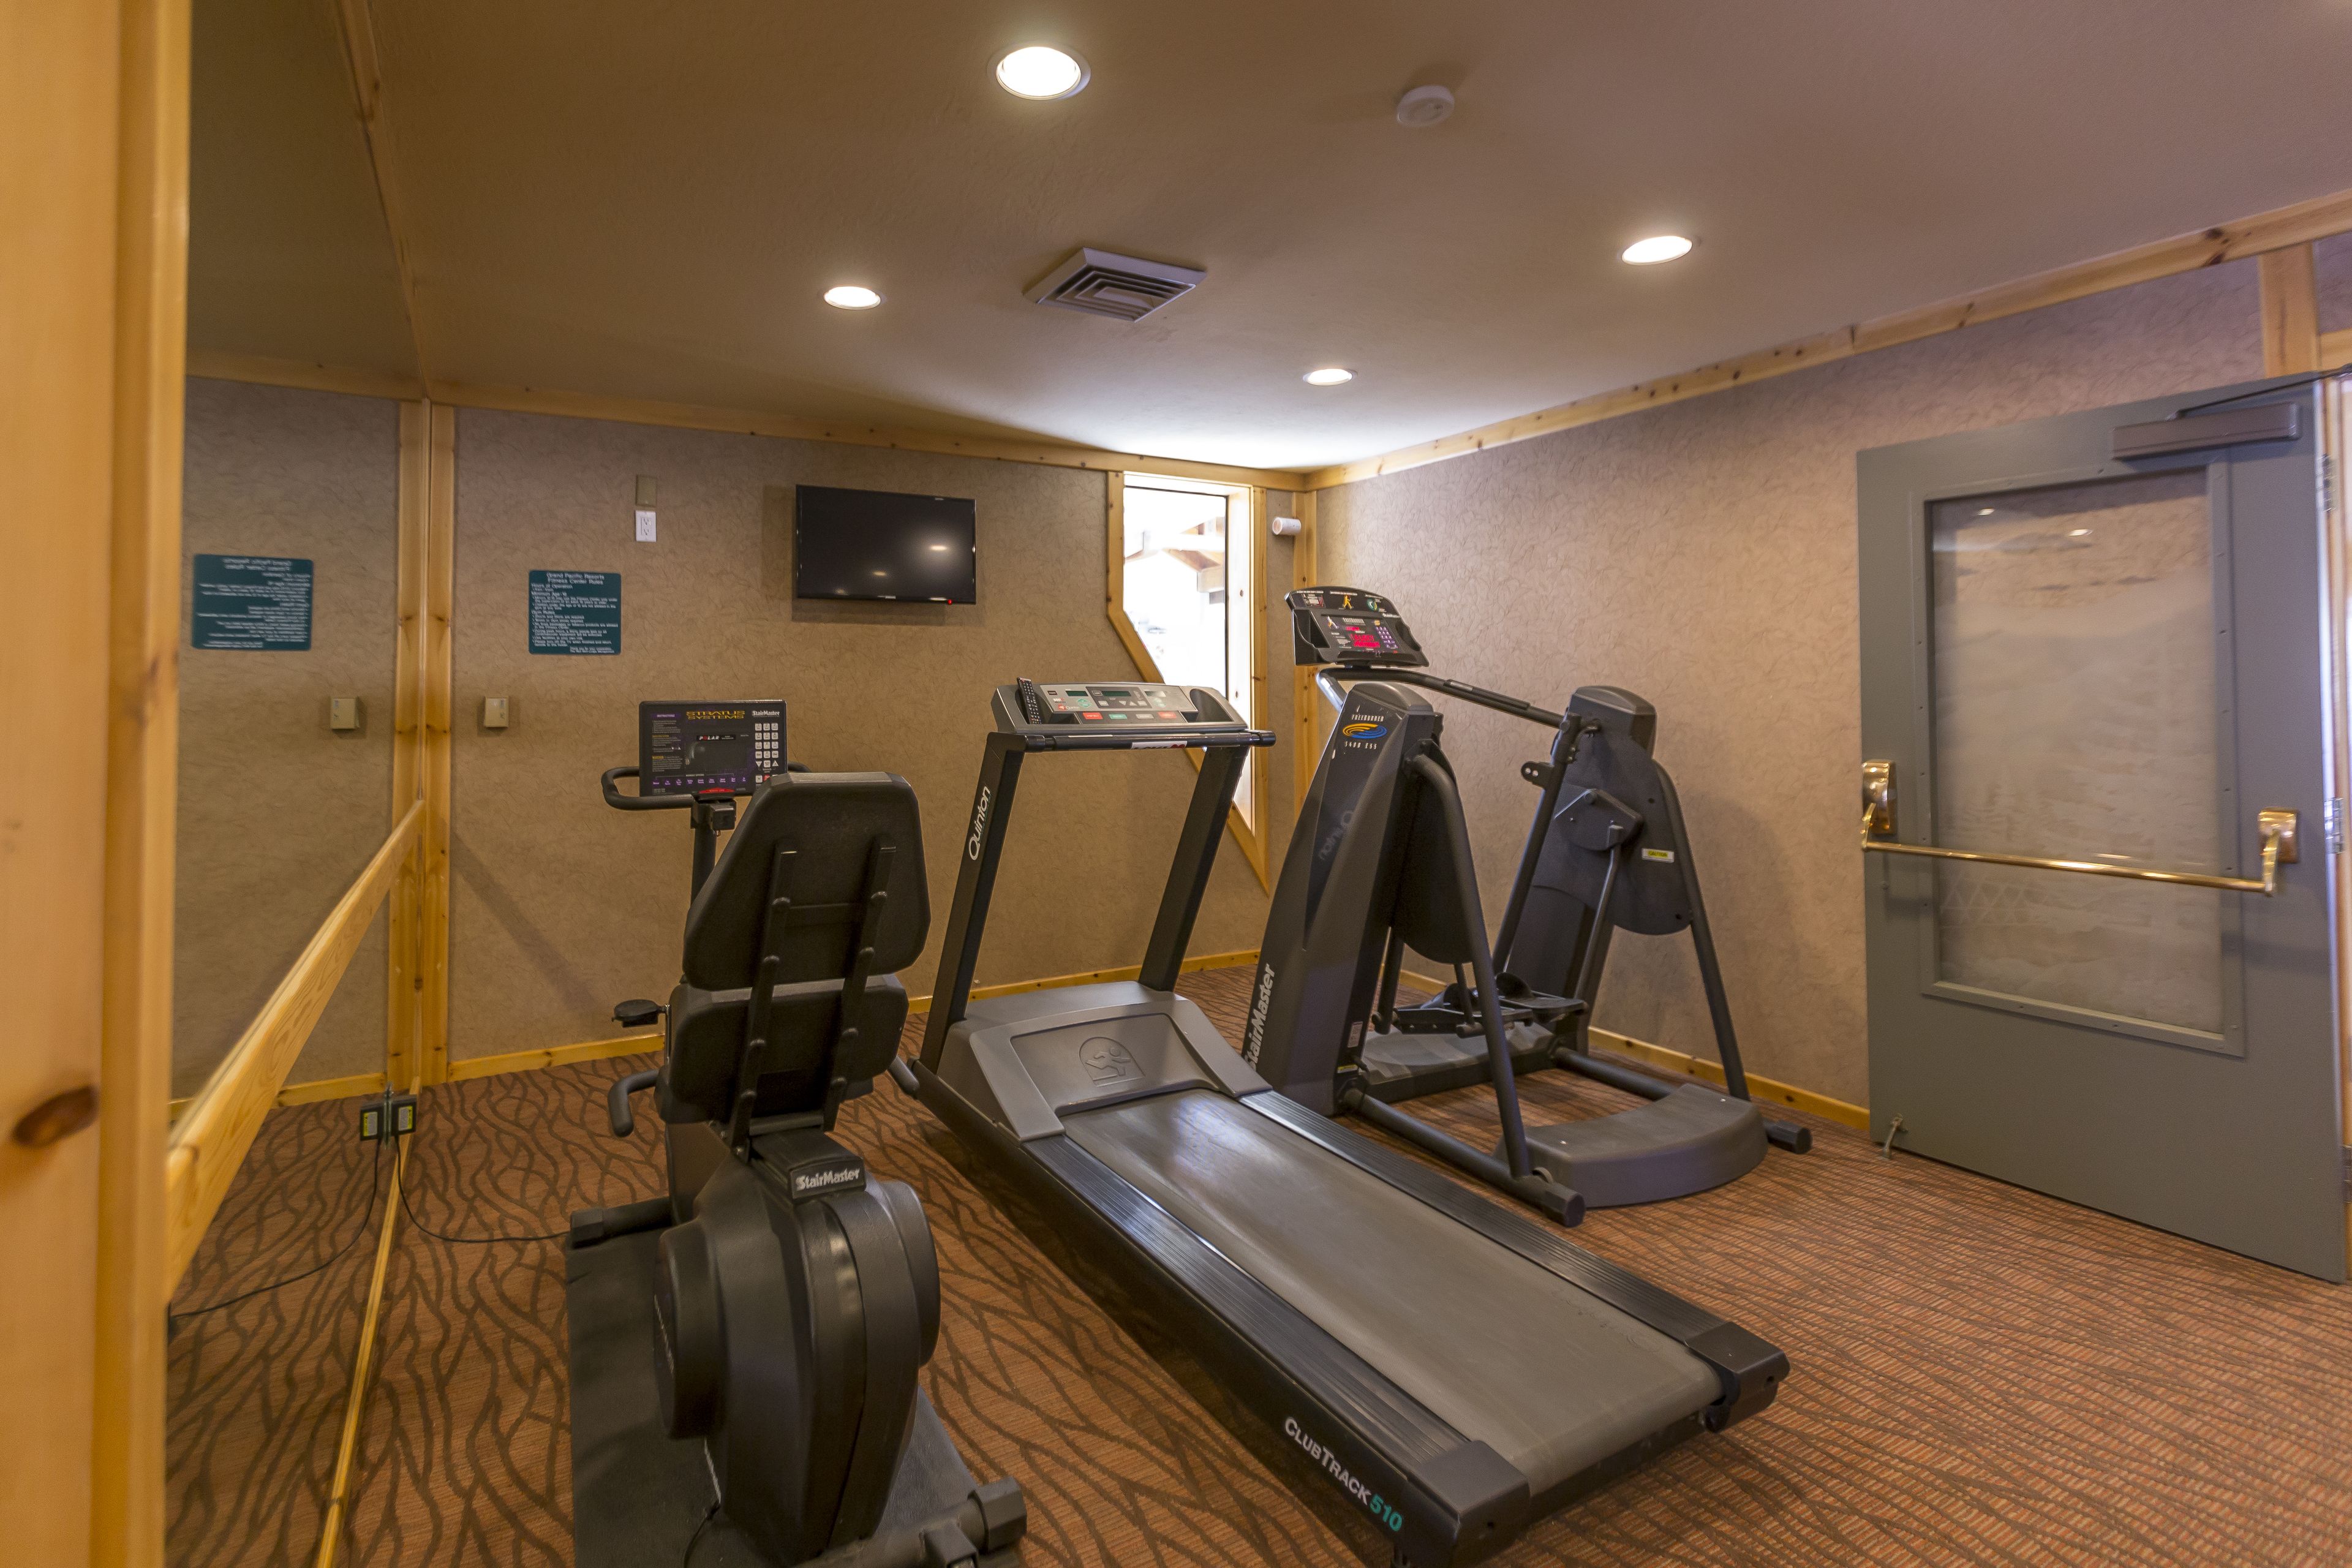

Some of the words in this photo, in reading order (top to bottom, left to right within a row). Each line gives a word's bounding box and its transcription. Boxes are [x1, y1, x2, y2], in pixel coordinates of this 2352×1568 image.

[969, 786, 990, 861] Quinton
[1245, 963, 1275, 1072] StairMaster
[796, 1168, 860, 1191] StairMaster
[1369, 1493, 1403, 1532] 510
